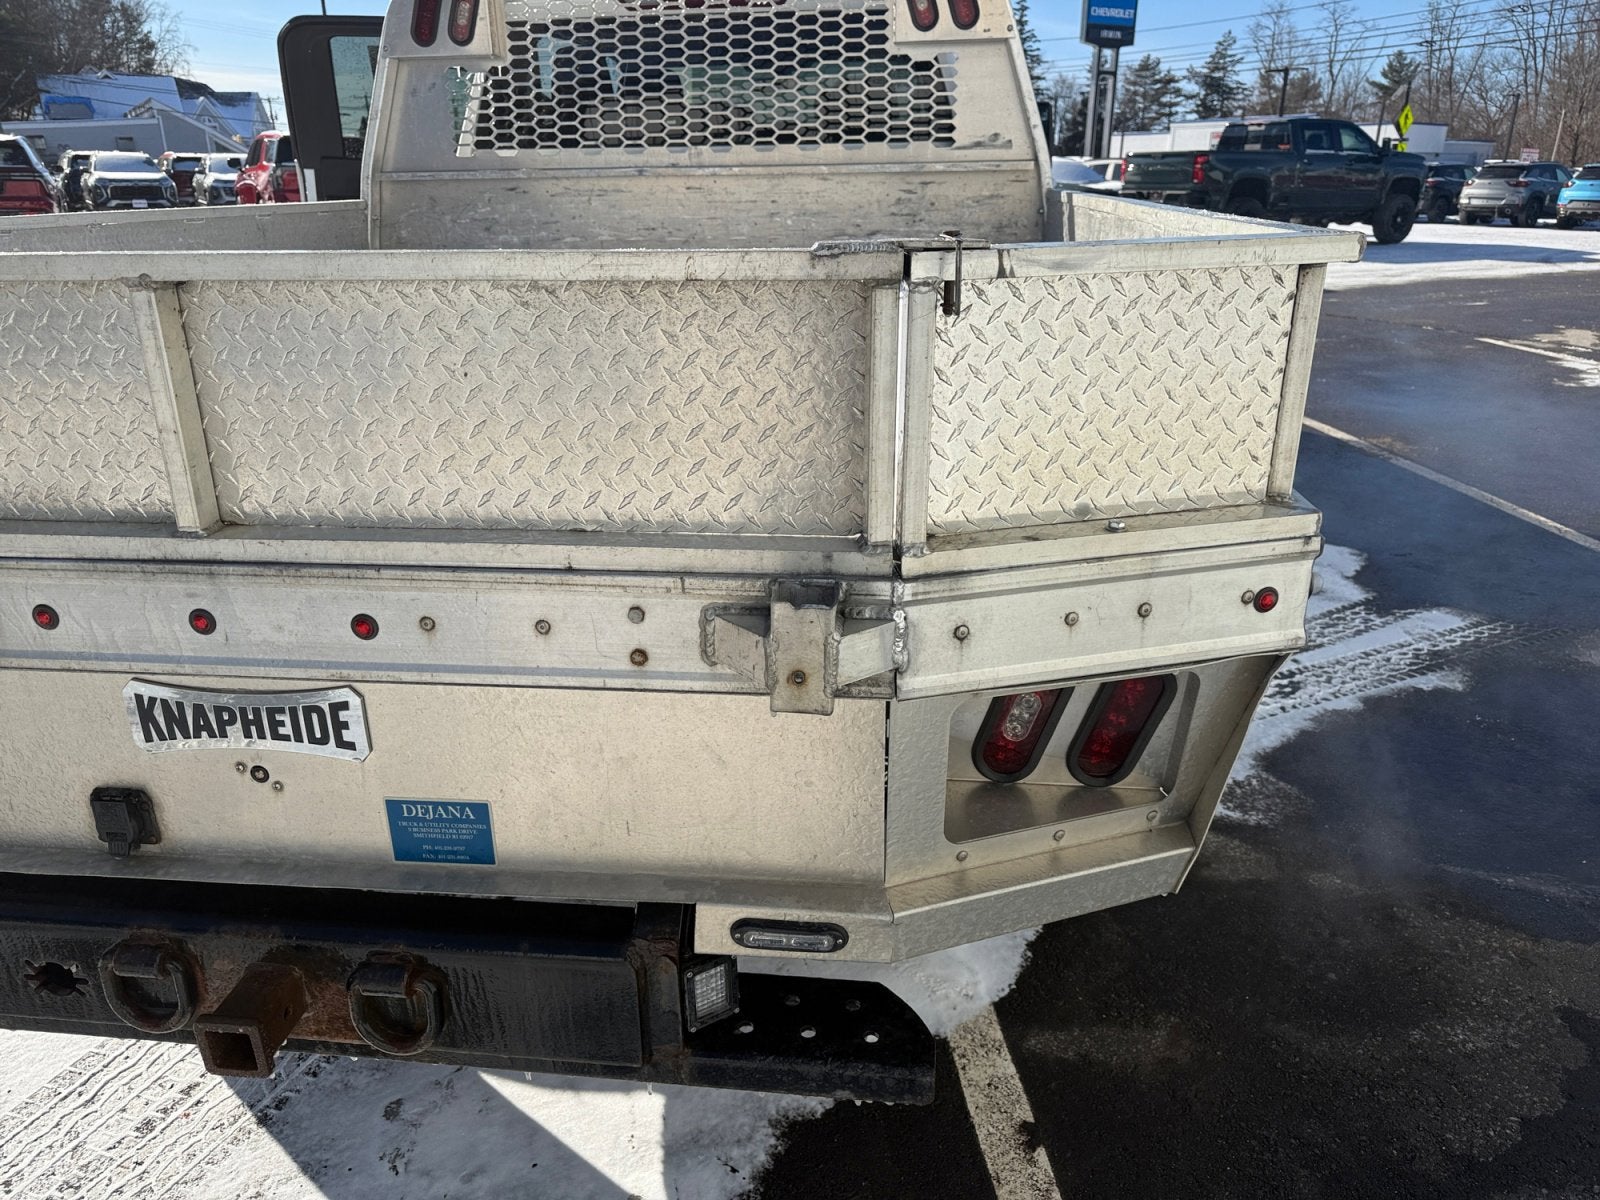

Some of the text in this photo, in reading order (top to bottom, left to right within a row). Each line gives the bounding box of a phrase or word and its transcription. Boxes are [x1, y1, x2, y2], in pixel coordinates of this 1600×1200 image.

[1090, 6, 1134, 18] CHEVROLET
[134, 692, 357, 751] KNAPHEIDE
[401, 804, 476, 820] DEJANA
